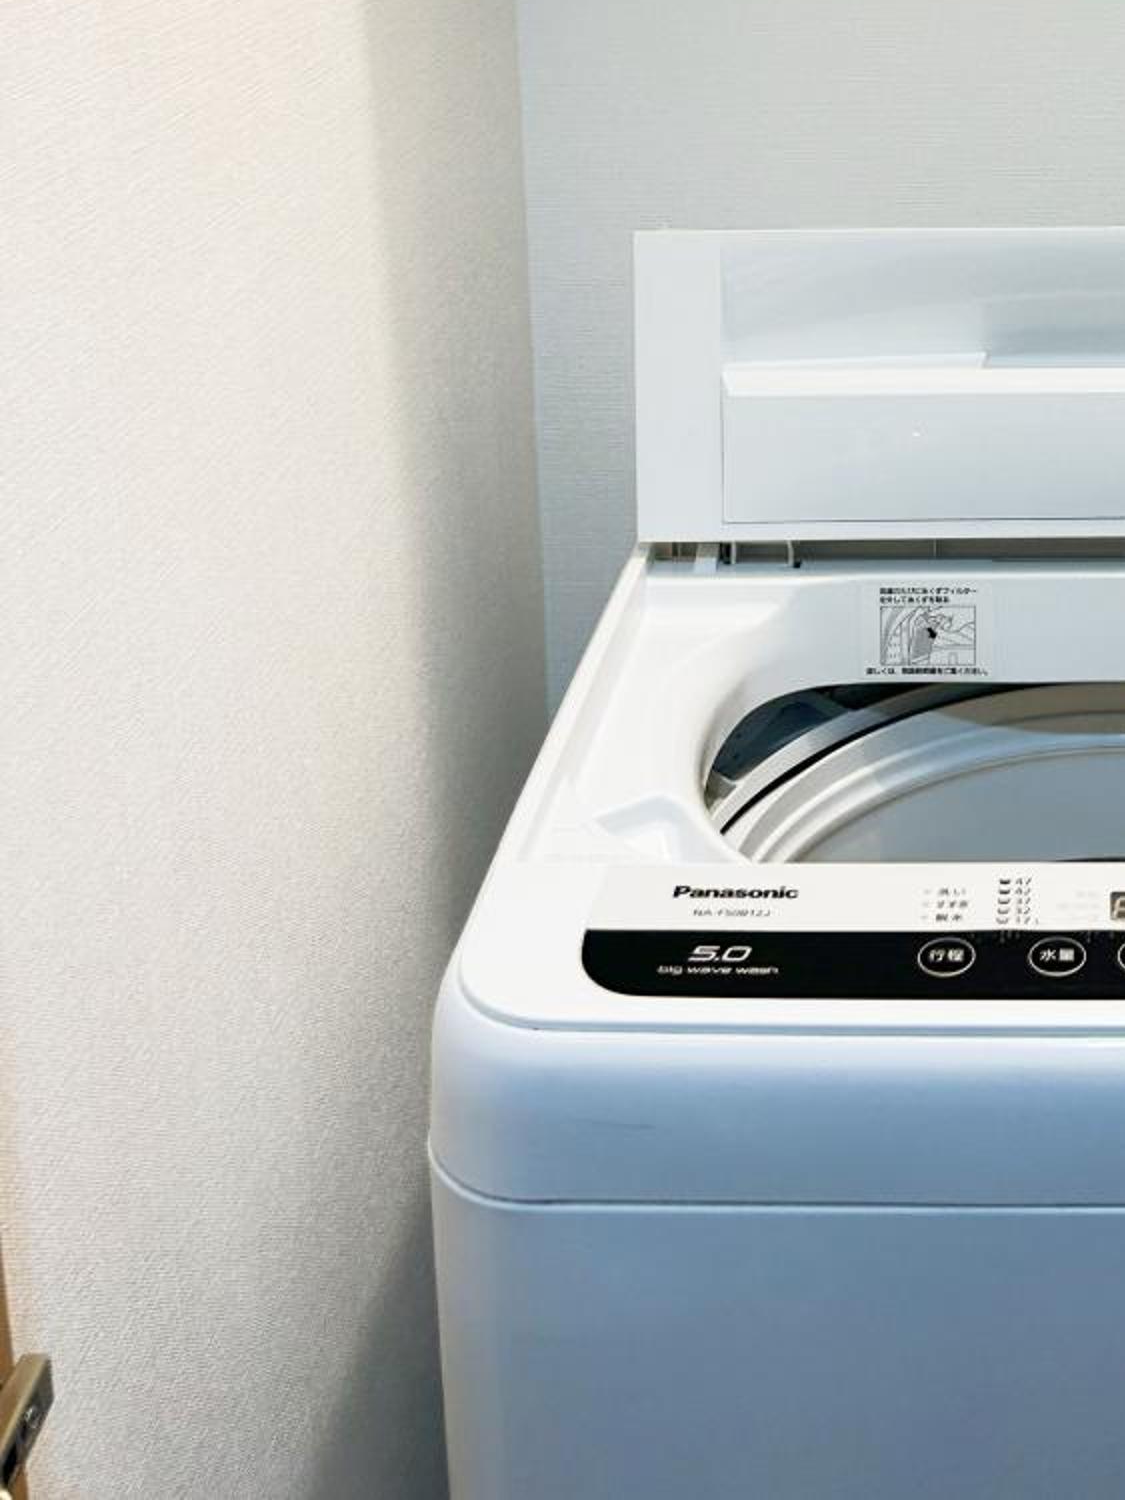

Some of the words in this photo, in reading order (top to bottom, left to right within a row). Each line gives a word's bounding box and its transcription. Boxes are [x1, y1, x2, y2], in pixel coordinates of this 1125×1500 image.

[672, 884, 799, 899] Panasonic
[687, 945, 753, 963] 5.0
[656, 965, 684, 977] big
[686, 965, 732, 976] wave
[735, 965, 780, 976] wash
